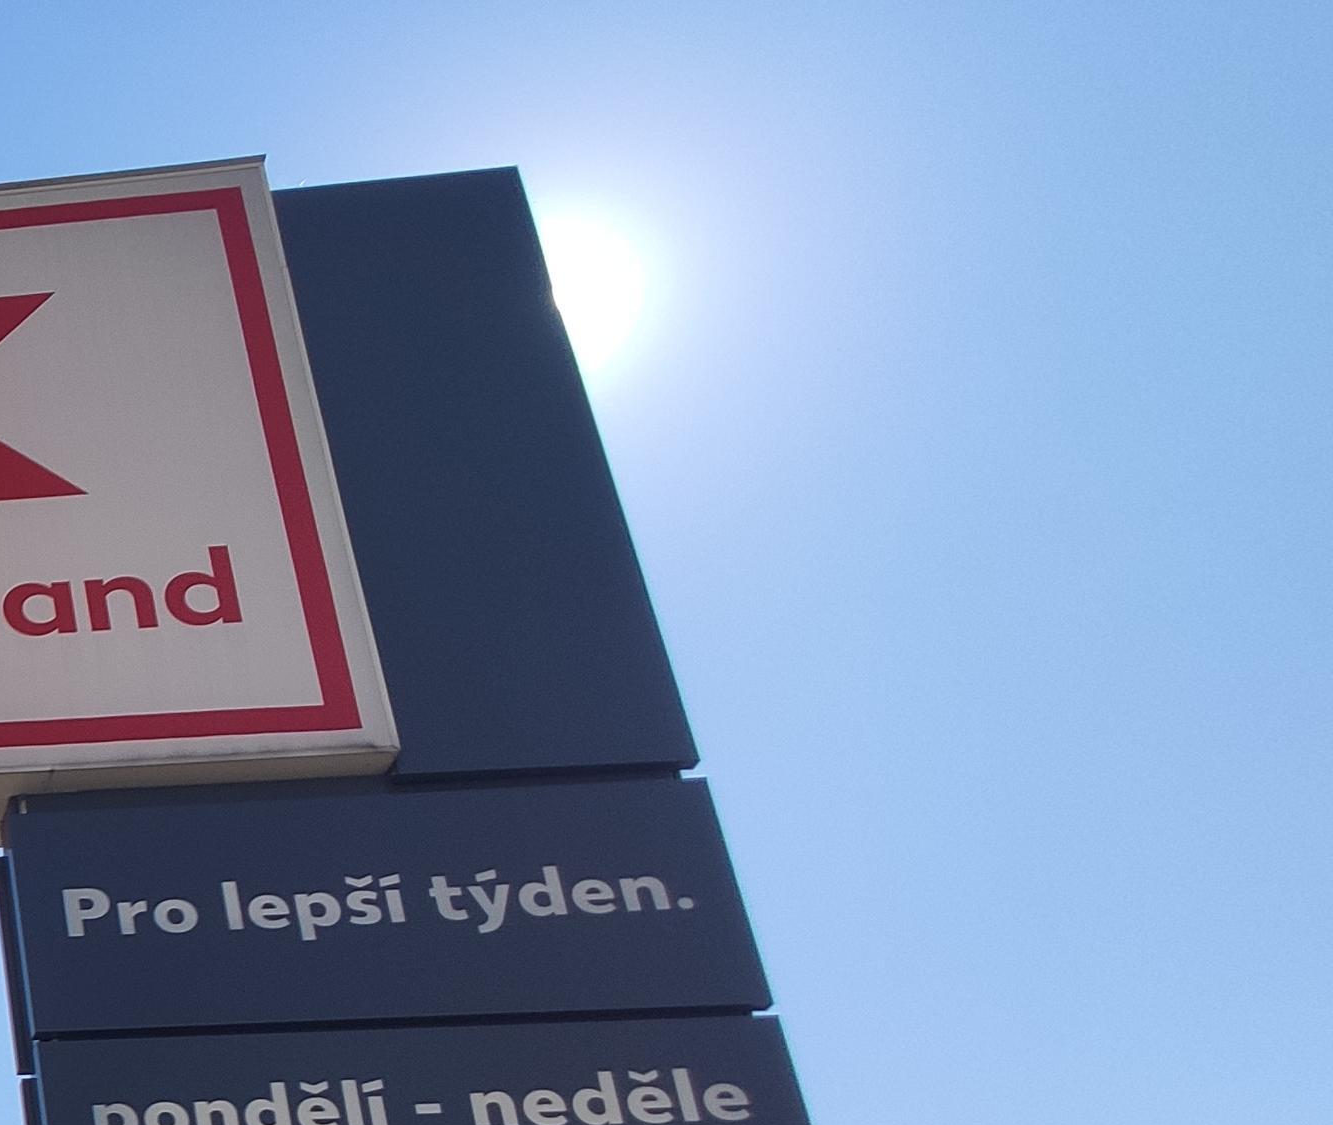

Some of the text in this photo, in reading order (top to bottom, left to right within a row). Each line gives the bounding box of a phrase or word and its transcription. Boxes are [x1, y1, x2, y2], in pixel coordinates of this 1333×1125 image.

[62, 865, 695, 941] Pro lepší týden.
[414, 1102, 442, 1115] -
